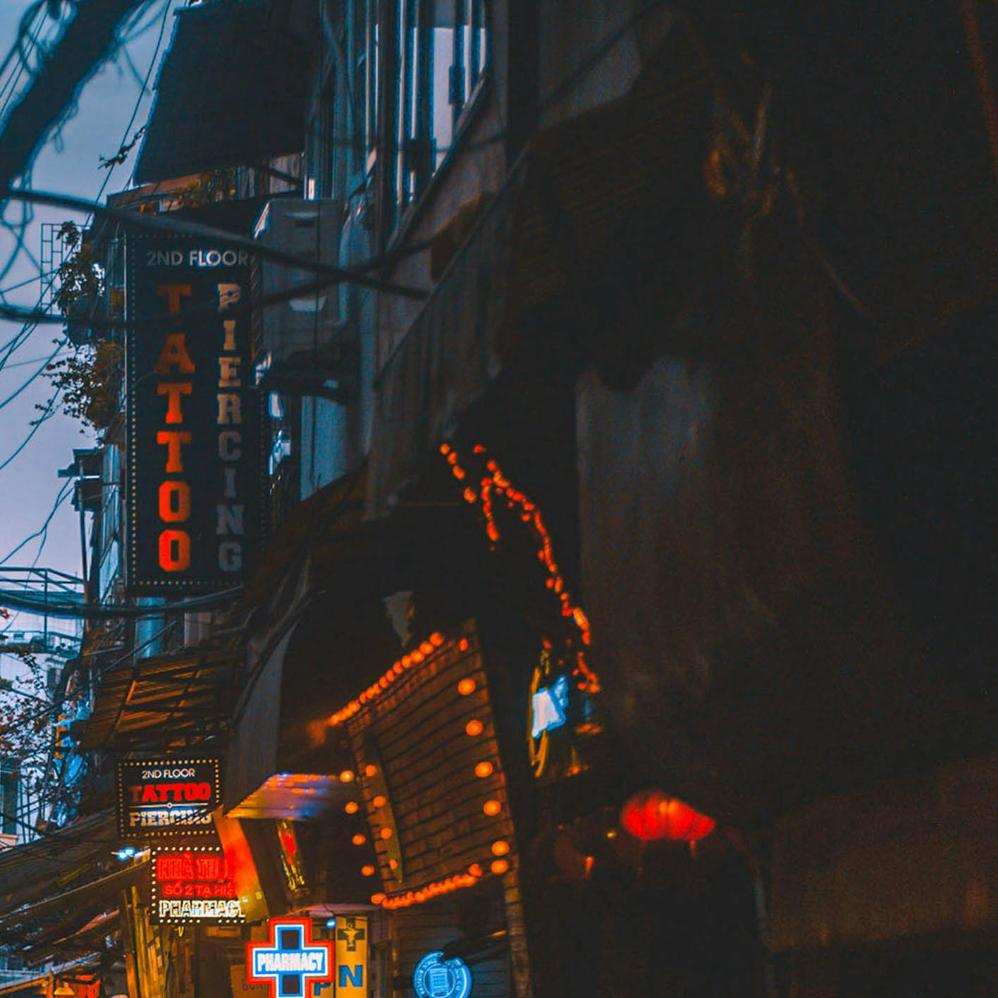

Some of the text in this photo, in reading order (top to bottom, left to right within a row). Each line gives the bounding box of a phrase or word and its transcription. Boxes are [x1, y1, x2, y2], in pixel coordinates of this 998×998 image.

[146, 250, 248, 266] 2ND FLOOR
[154, 283, 196, 572] TATTOO
[216, 282, 245, 572] PIERCING
[142, 768, 195, 779] 2ND FLOOR
[128, 783, 211, 801] TATTOO
[130, 809, 212, 827] PIERCING
[164, 879, 182, 896] SỐ
[185, 885, 193, 896] 2
[214, 882, 236, 898] HIỆ
[257, 952, 323, 971] PHARMACY
